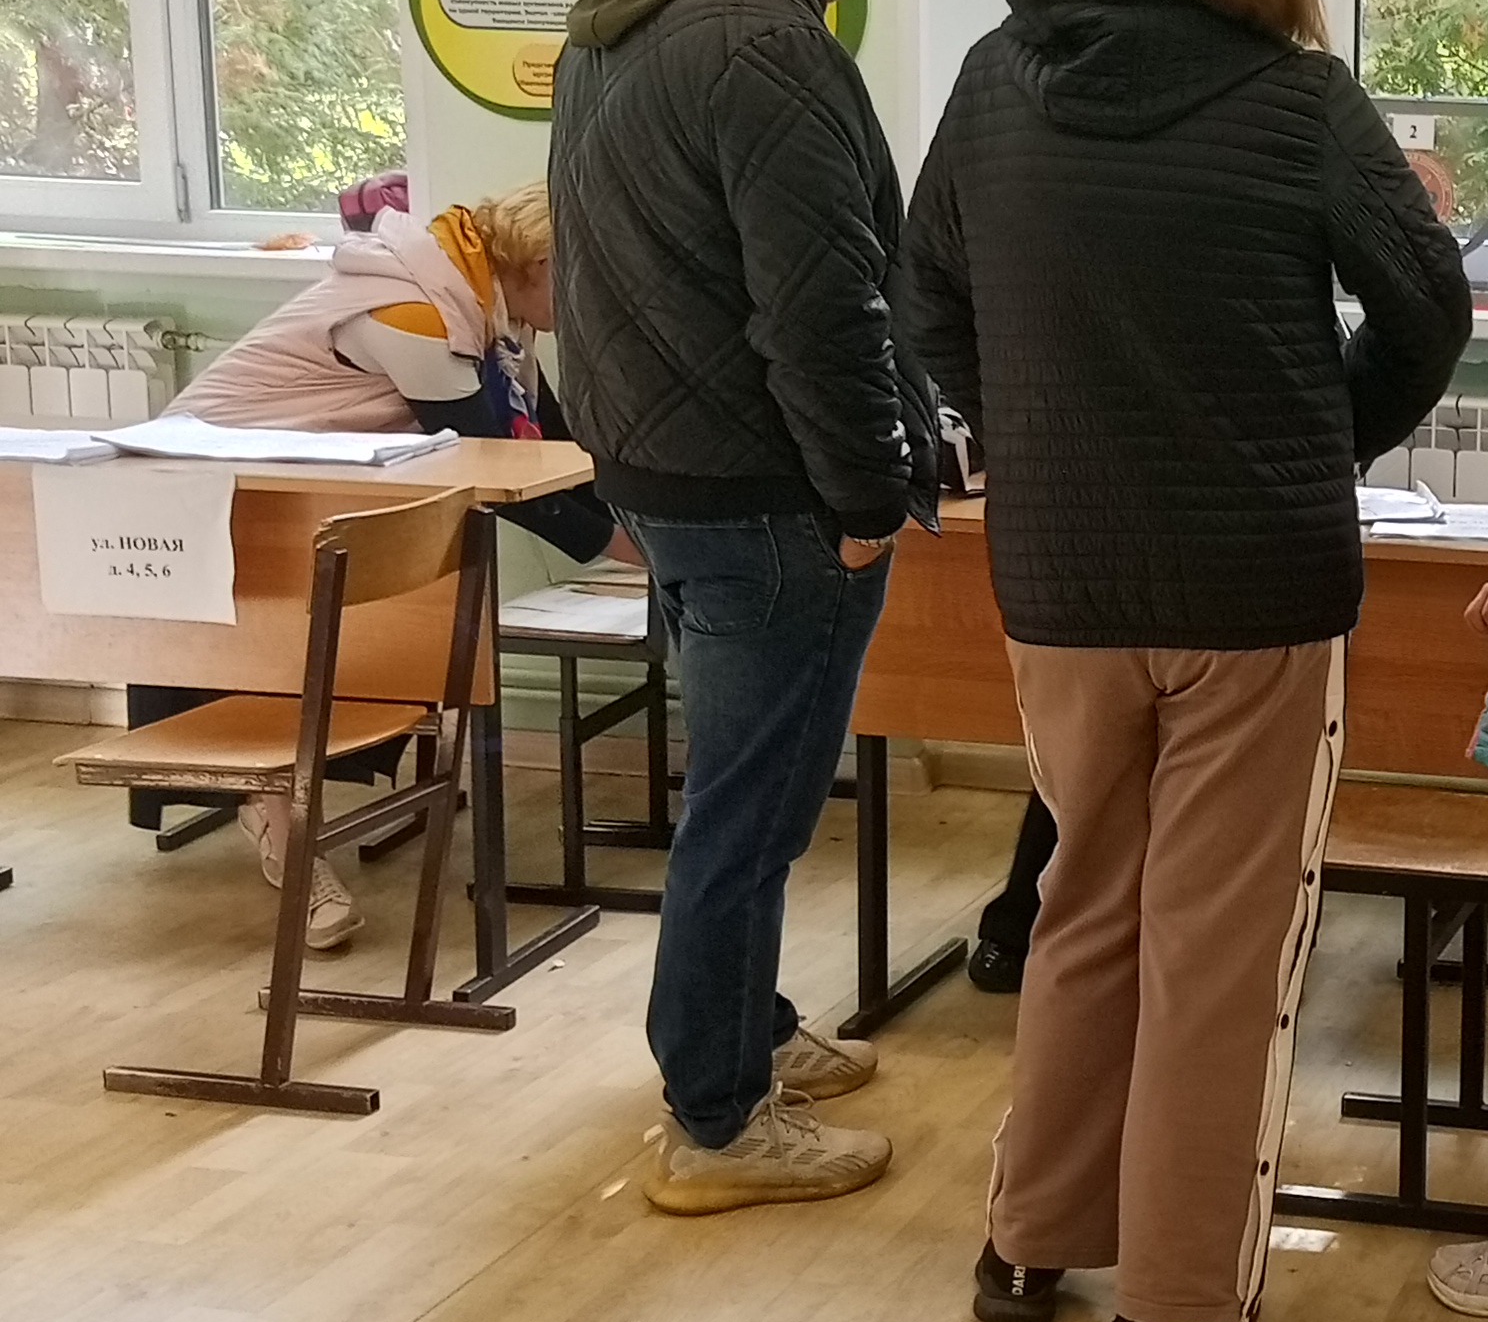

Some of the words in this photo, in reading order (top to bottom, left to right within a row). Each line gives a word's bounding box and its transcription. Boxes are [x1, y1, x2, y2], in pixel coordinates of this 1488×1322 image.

[1408, 125, 1418, 139] 2
[91, 536, 114, 552] ул.
[119, 536, 183, 552] НОВАЯ
[109, 564, 122, 576] д.
[126, 563, 140, 578] 4,
[144, 563, 158, 578] 5,
[162, 564, 171, 578] 6
